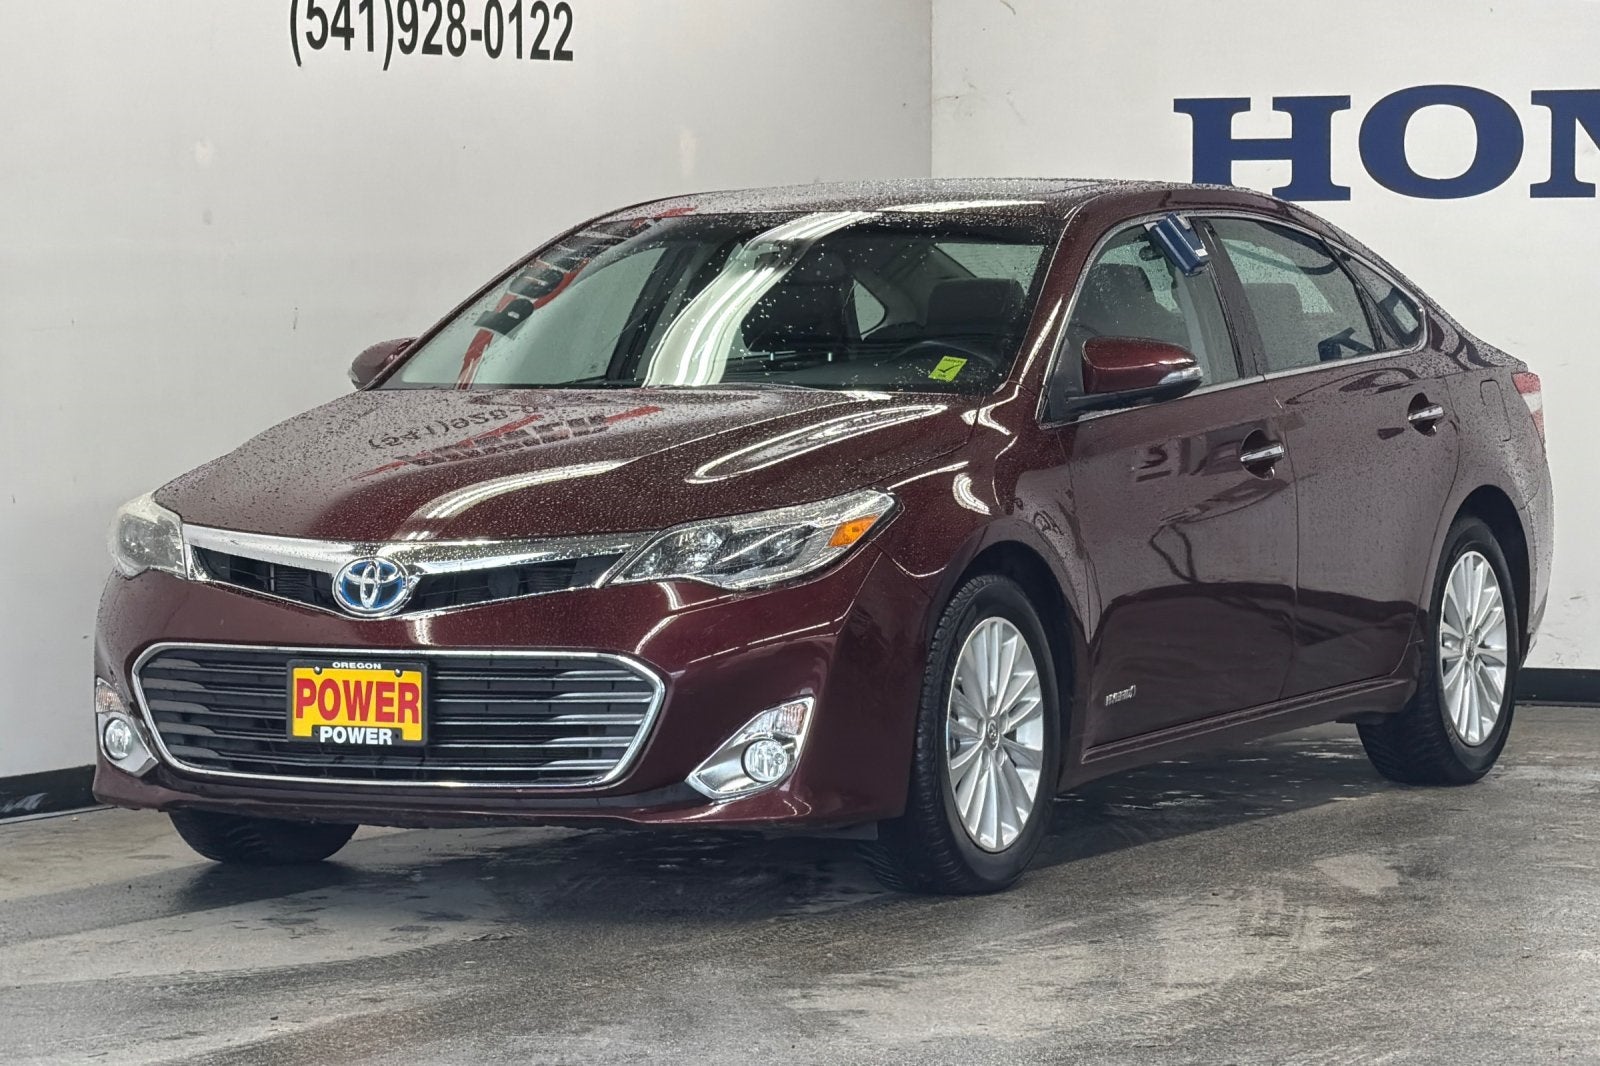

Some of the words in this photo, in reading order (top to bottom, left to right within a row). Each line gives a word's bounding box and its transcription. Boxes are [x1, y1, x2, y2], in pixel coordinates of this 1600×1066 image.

[289, 0, 574, 71] (541)928-0122
[331, 661, 382, 670] OREGON
[295, 677, 420, 724] POWER
[319, 726, 393, 746] POWER
